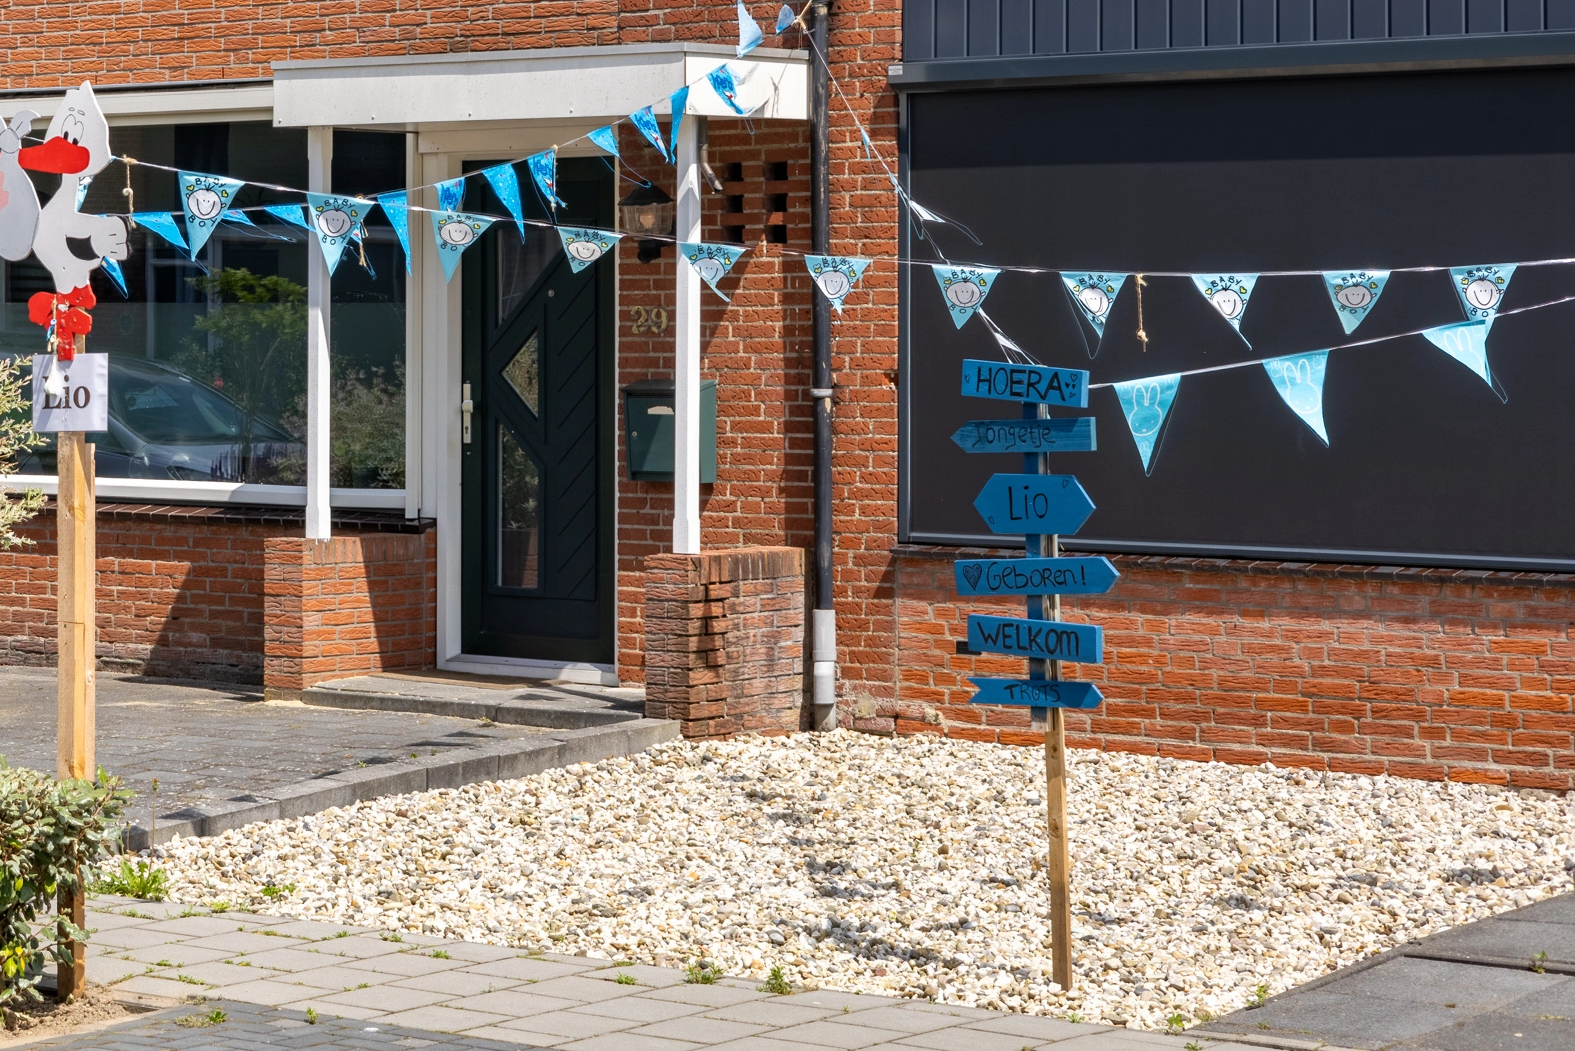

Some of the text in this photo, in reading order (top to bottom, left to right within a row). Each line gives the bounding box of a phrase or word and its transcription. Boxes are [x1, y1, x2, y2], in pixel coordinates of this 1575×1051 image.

[324, 198, 355, 209] BABY
[188, 215, 217, 227] BOY
[322, 235, 347, 245] BOY
[951, 269, 983, 279] BABY
[1466, 266, 1500, 277] BABY
[1078, 274, 1111, 285] BABY
[1210, 276, 1242, 288] BABY
[1341, 272, 1373, 284] BABY
[1339, 305, 1369, 314] BOY
[630, 305, 669, 334] 29
[976, 366, 1066, 401] HOERA
[42, 375, 91, 409] Lio
[1003, 683, 1061, 702] TROTS
